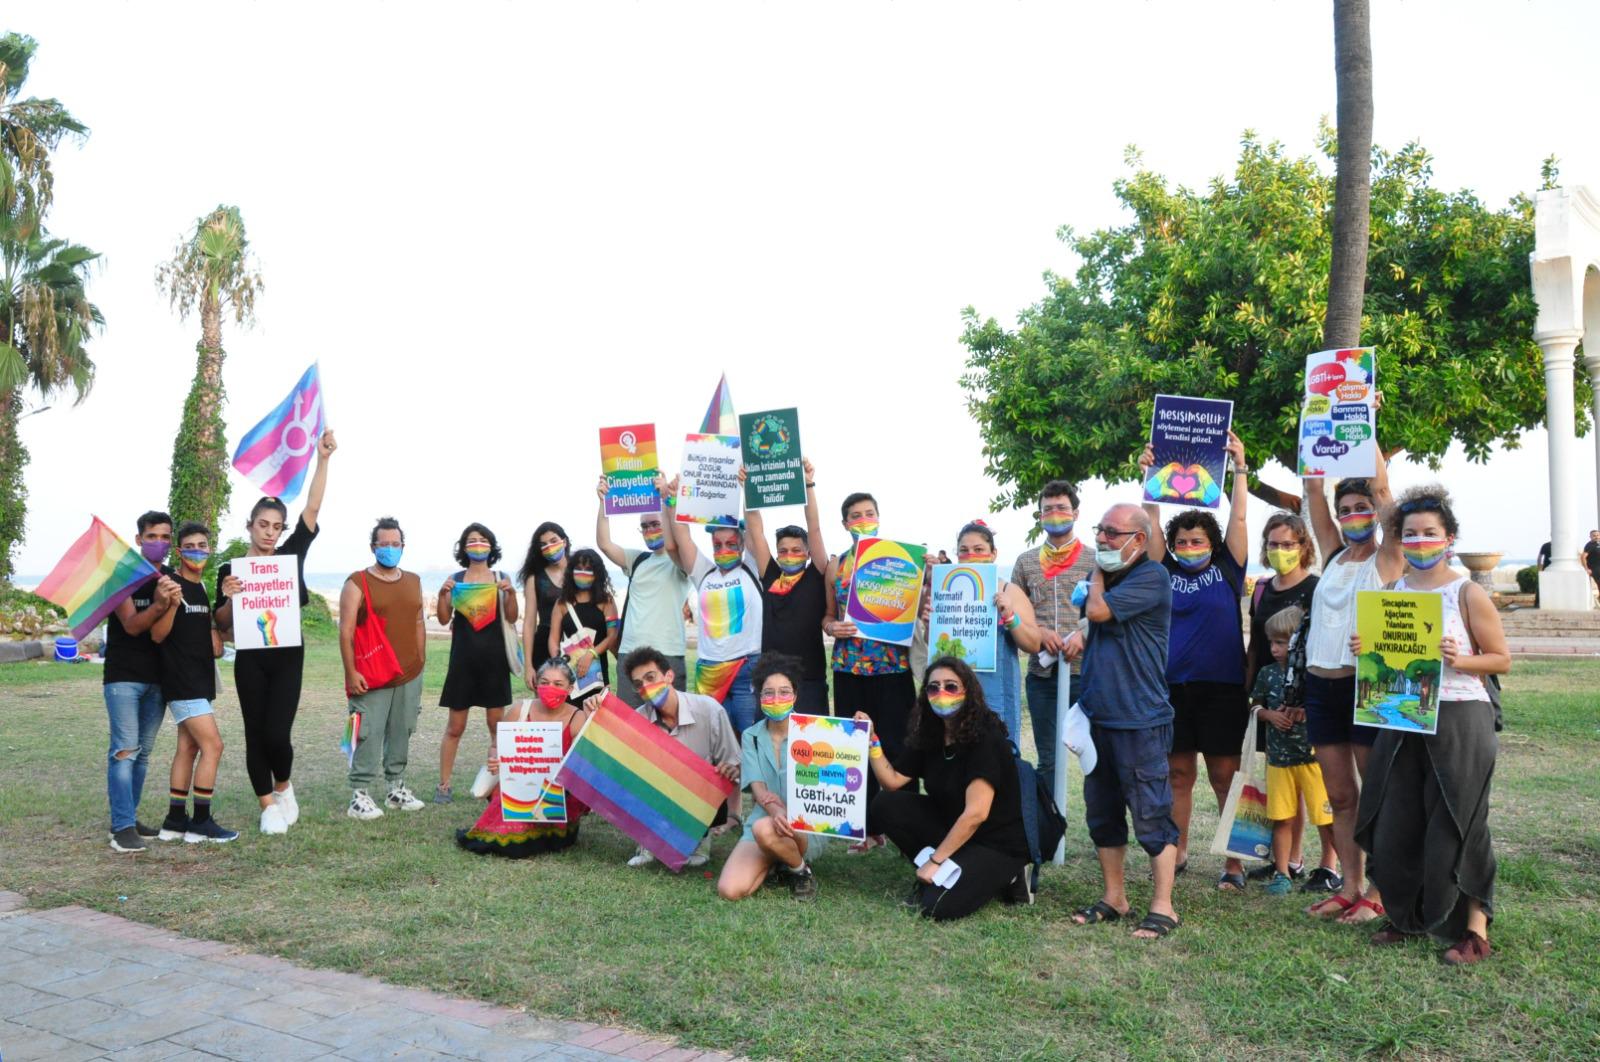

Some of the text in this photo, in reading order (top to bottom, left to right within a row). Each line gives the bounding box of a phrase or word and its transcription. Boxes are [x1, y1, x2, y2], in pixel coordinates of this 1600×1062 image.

[1343, 412, 1368, 421] Hakkı
[1156, 423, 1224, 436] söylemesi zor fakat
[1339, 425, 1364, 434] Sağlık
[1164, 432, 1213, 445] kendisi güzel.
[1345, 432, 1369, 441] Hakkı
[1315, 444, 1346, 455] Vardır!
[687, 453, 736, 466] Bütün insanlar
[761, 460, 786, 471] krizinin
[786, 457, 801, 469] faili
[683, 470, 703, 479] ONUR
[711, 473, 738, 482] HAKLAR
[750, 470, 795, 486] aynı zamanda
[696, 479, 738, 489] BAKIMINDAN
[757, 482, 790, 494] transların
[681, 485, 701, 499] EŞİT
[763, 493, 785, 504] failidir
[612, 492, 655, 507] Politiktir!
[250, 562, 279, 575] Trans
[242, 595, 290, 610] Politiktir!
[933, 590, 964, 602] Normatif
[935, 603, 988, 617] düzenin dışına
[964, 615, 993, 628] kesişip
[1385, 620, 1414, 630] Yılanların
[952, 627, 990, 641] birleşiyor.
[1382, 630, 1418, 642] ONURUNU
[1374, 641, 1427, 656] HAYKIRACAĞIZ!
[501, 756, 560, 764] korktuğunuzu
[793, 748, 861, 761] YAŞLI ENGELLİ ÖĞRENCİ
[509, 766, 550, 774] biliyoruz!
[796, 769, 819, 778] MÜLTECİ
[822, 770, 844, 778] EBEVEYN
[796, 788, 856, 805] LGBTİ+'LAR
[804, 803, 846, 818] VARDIR!
